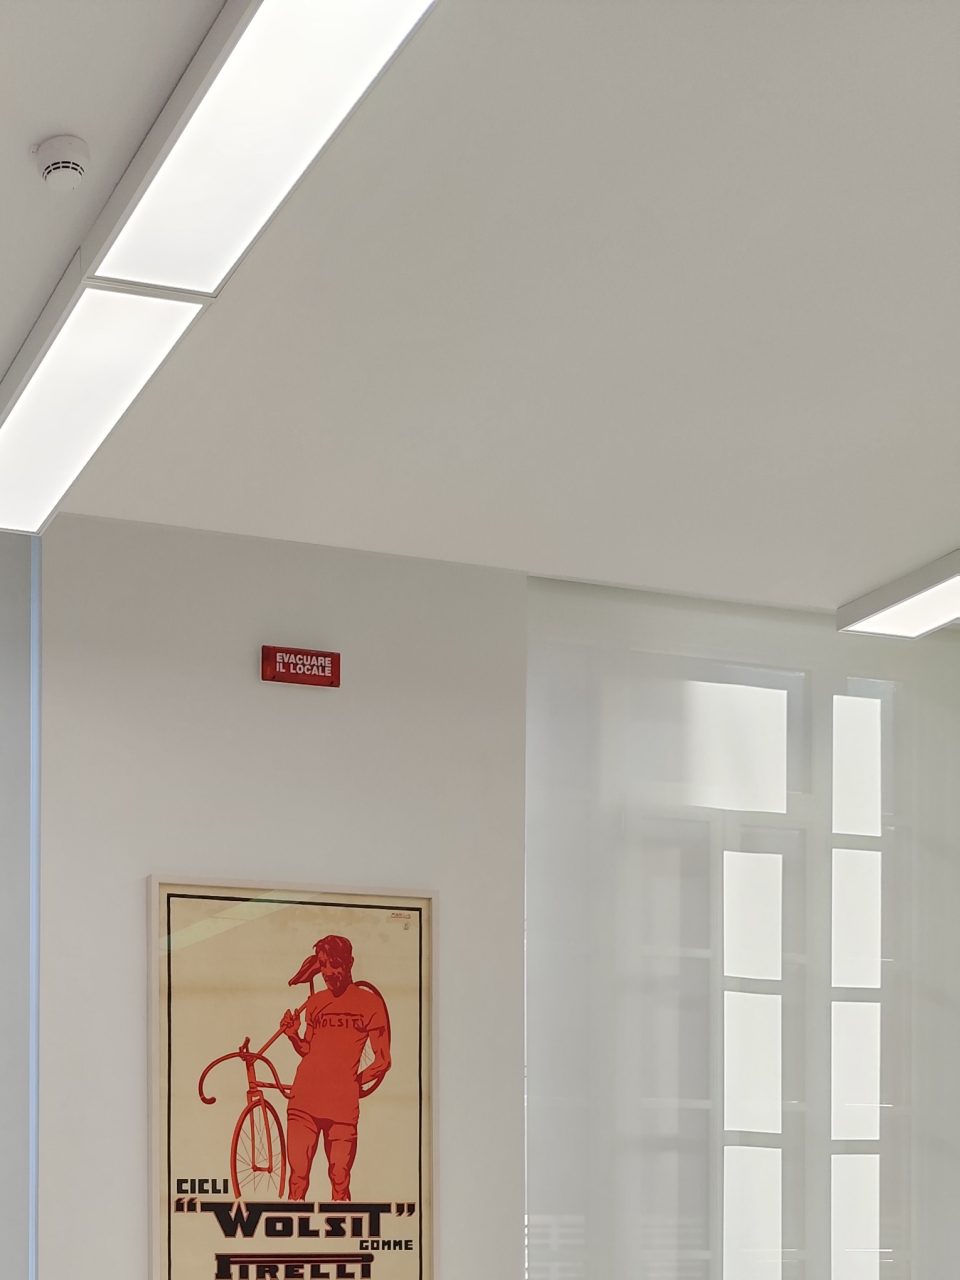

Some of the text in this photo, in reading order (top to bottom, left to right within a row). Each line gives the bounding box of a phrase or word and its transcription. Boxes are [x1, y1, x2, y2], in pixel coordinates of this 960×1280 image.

[276, 653, 332, 667] EVACUARE
[276, 663, 332, 676] IL LOCALE
[177, 1179, 229, 1194] CICLI
[359, 1240, 414, 1251] GOMME
[215, 1253, 375, 1280] PIRELLI
